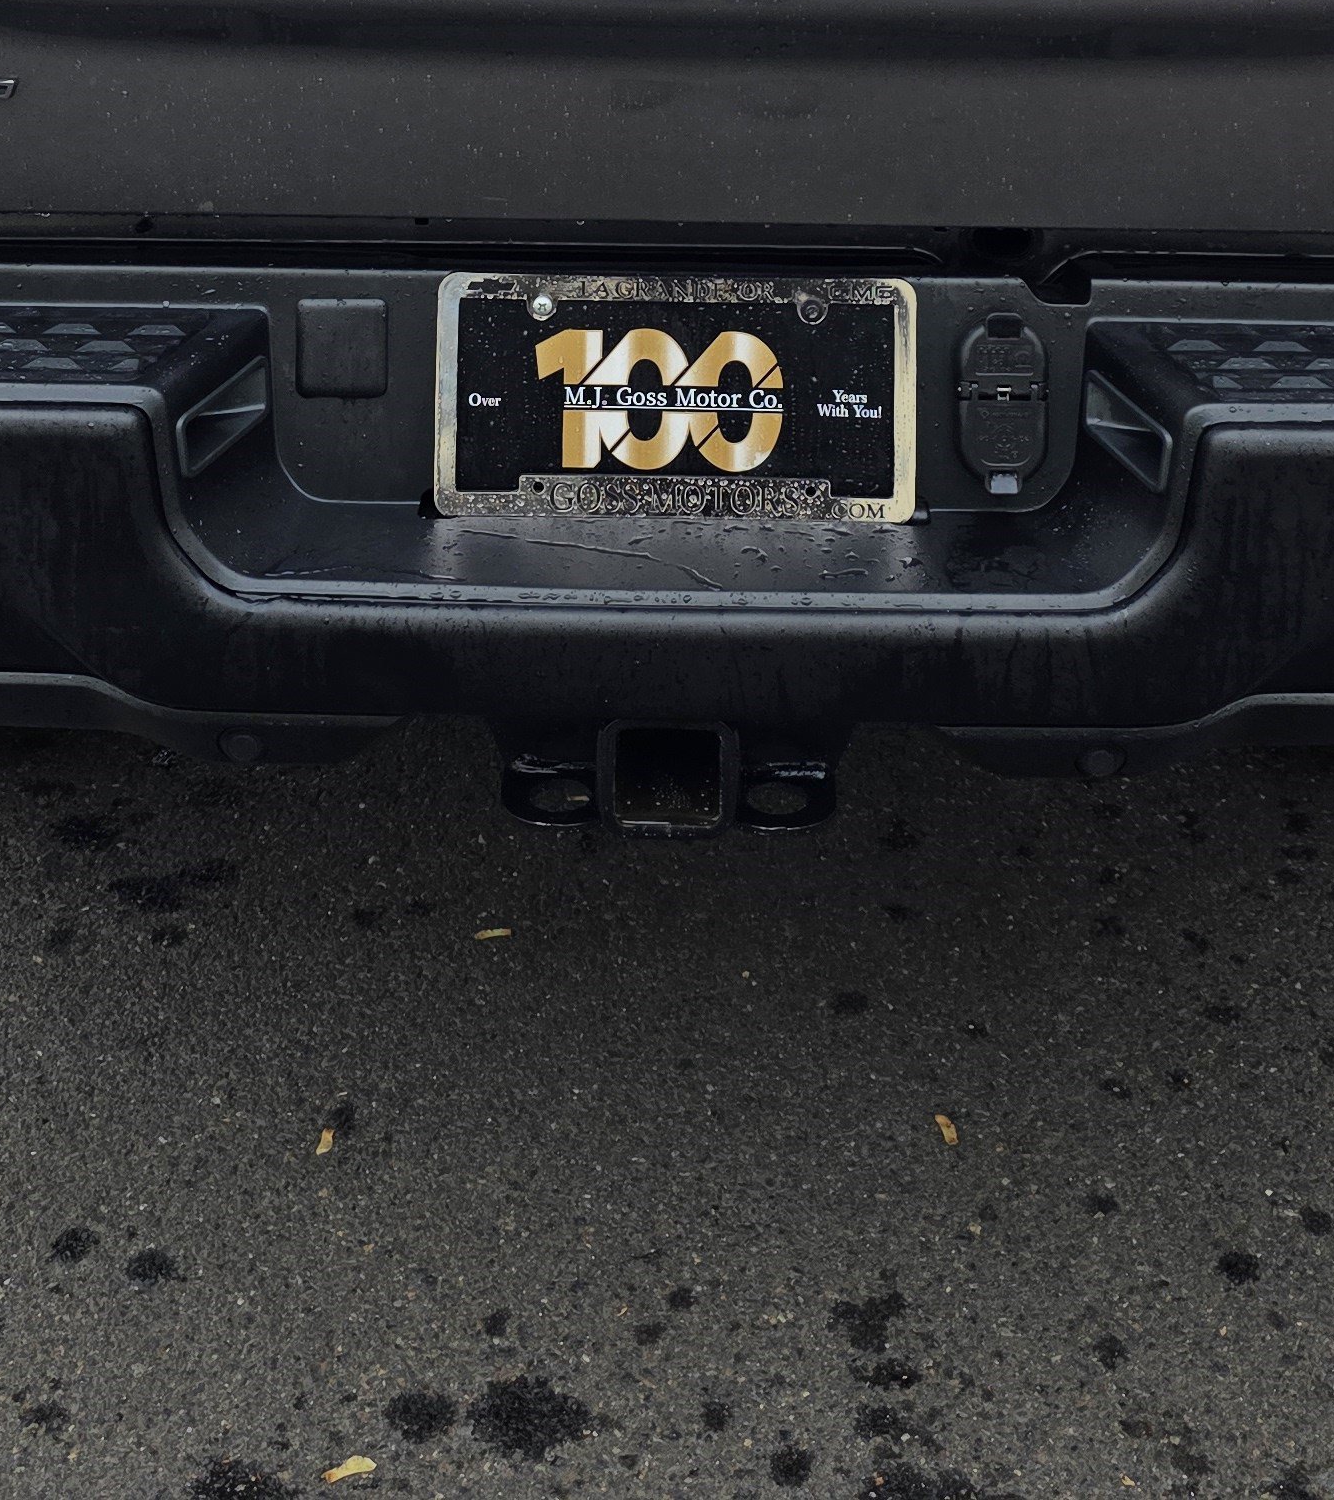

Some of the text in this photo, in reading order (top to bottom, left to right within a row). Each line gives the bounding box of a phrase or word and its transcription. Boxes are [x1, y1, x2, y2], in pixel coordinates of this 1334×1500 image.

[468, 393, 502, 408] Over
[535, 328, 783, 472] 100
[563, 386, 784, 410] M.J. Goss Motor Co.
[832, 389, 868, 405] Years
[816, 403, 883, 420] With You!
